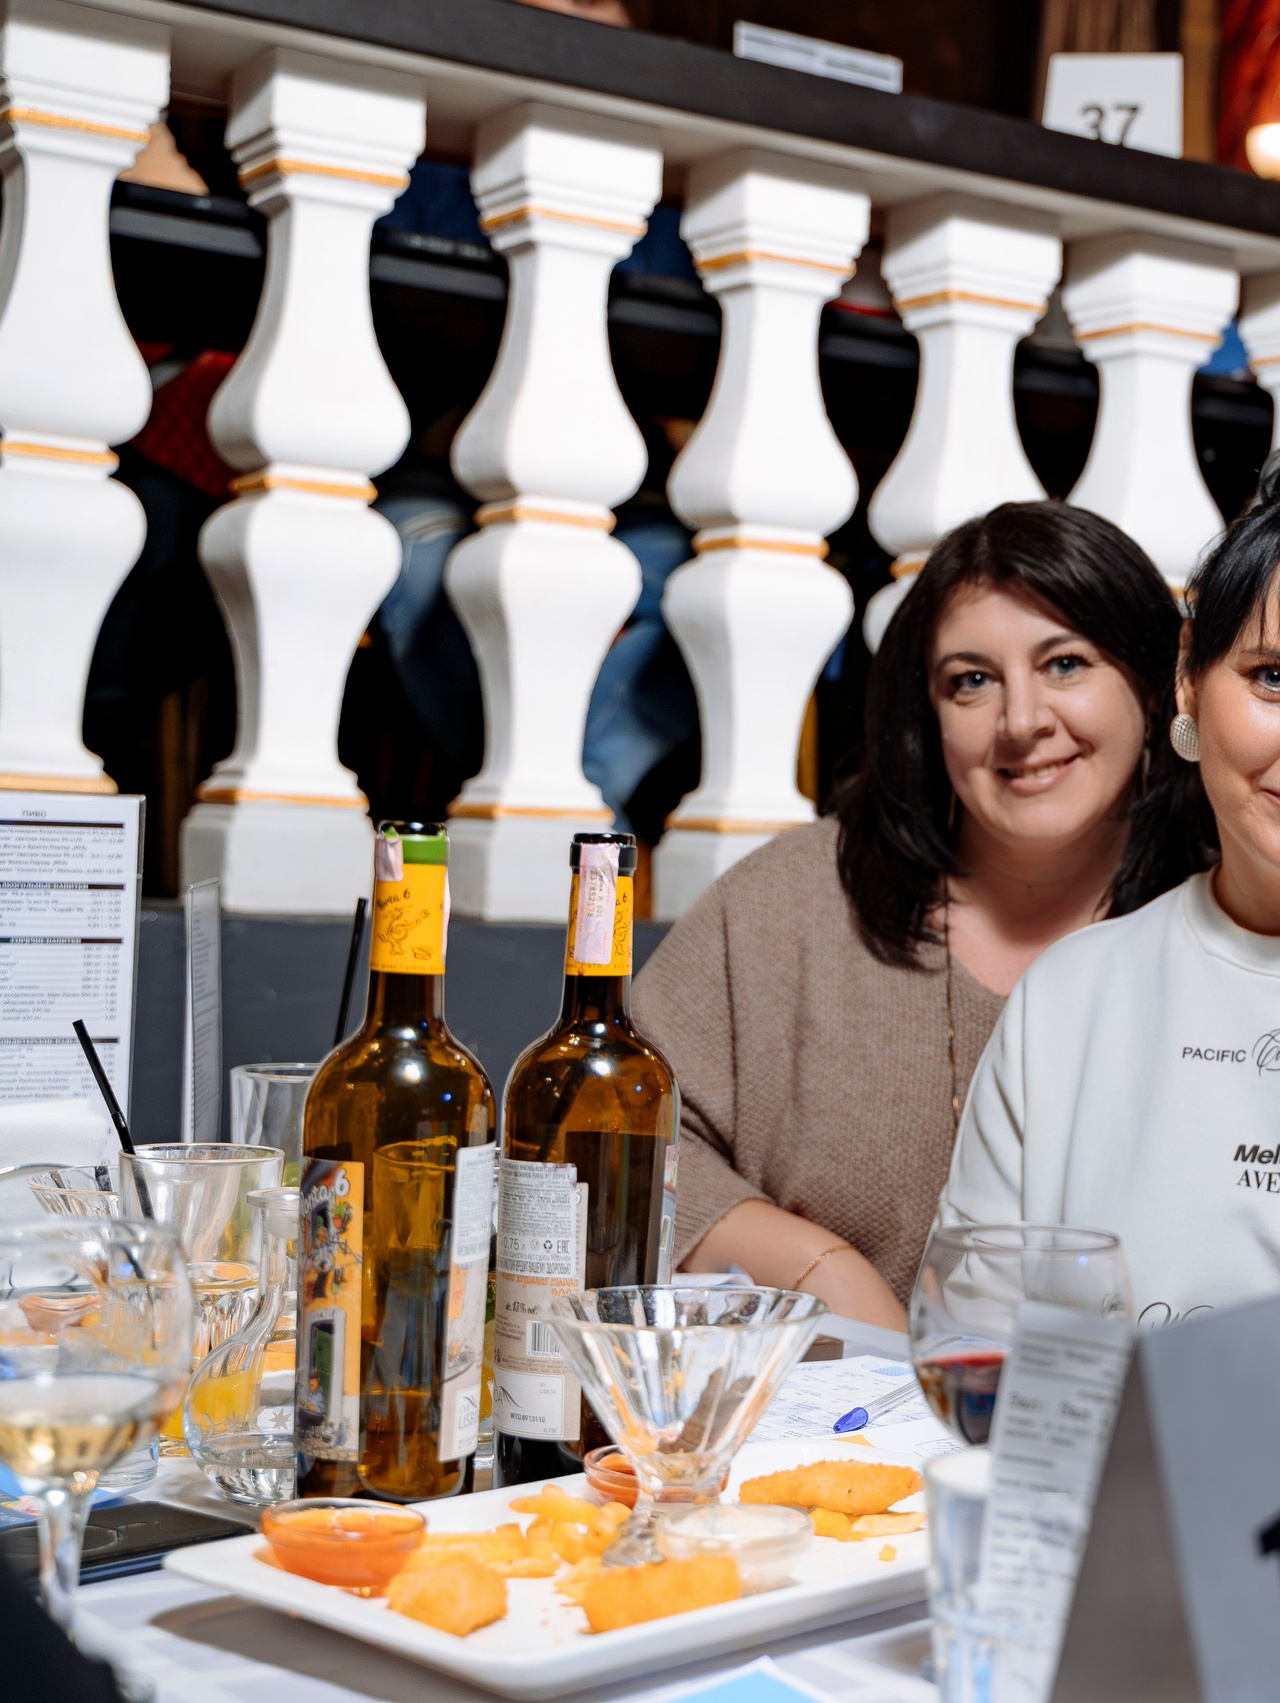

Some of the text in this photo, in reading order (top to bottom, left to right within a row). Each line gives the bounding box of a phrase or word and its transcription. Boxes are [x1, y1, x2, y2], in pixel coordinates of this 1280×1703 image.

[1080, 103, 1142, 147] 37
[21, 809, 47, 818] ПИВО
[403, 888, 411, 900] 6
[1182, 1045, 1247, 1064] PACIFIC
[335, 1168, 350, 1198] 6
